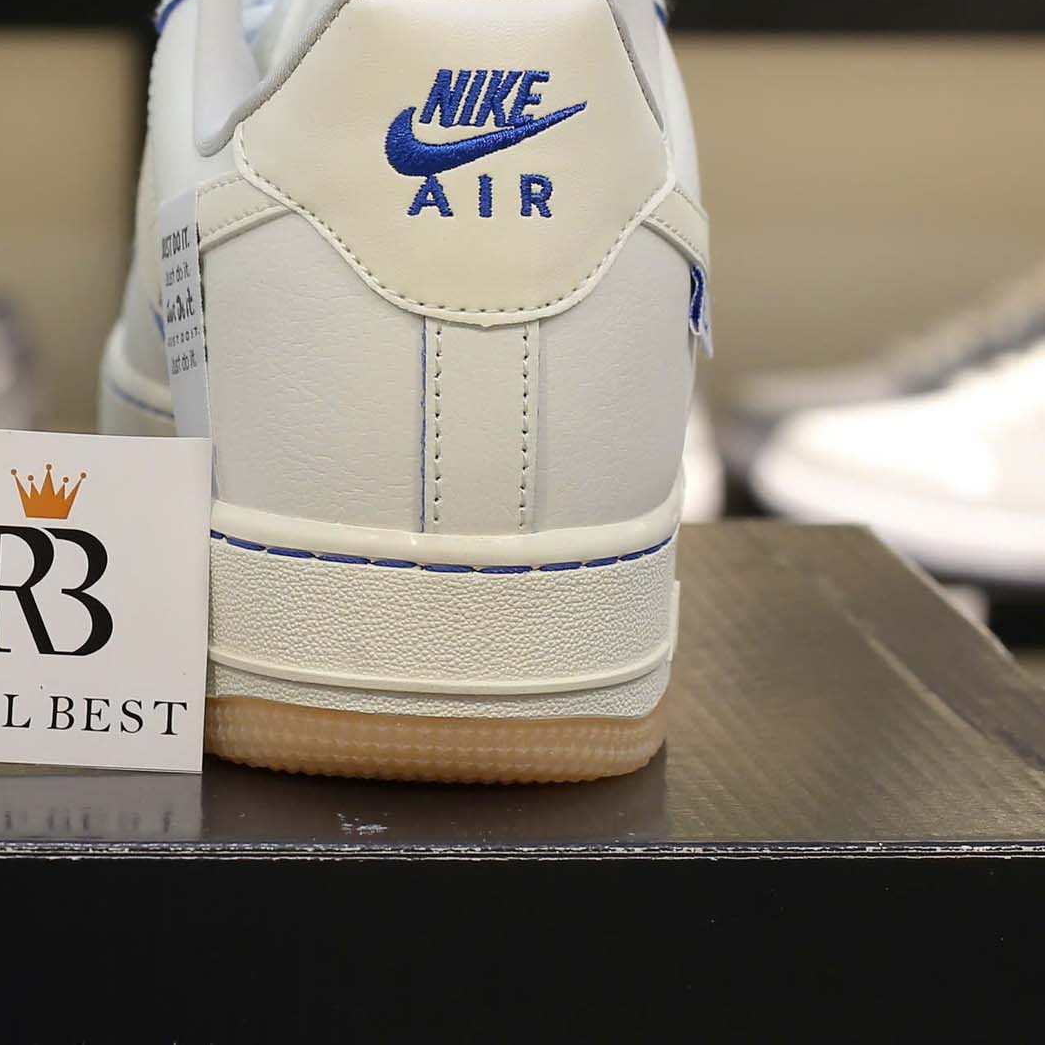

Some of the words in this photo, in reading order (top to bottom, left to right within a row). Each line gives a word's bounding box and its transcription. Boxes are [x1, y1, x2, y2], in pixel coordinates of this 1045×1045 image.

[419, 69, 550, 127] NIKE
[407, 174, 553, 218] AIR
[172, 231, 181, 255] DO
[47, 694, 188, 736] BEST
